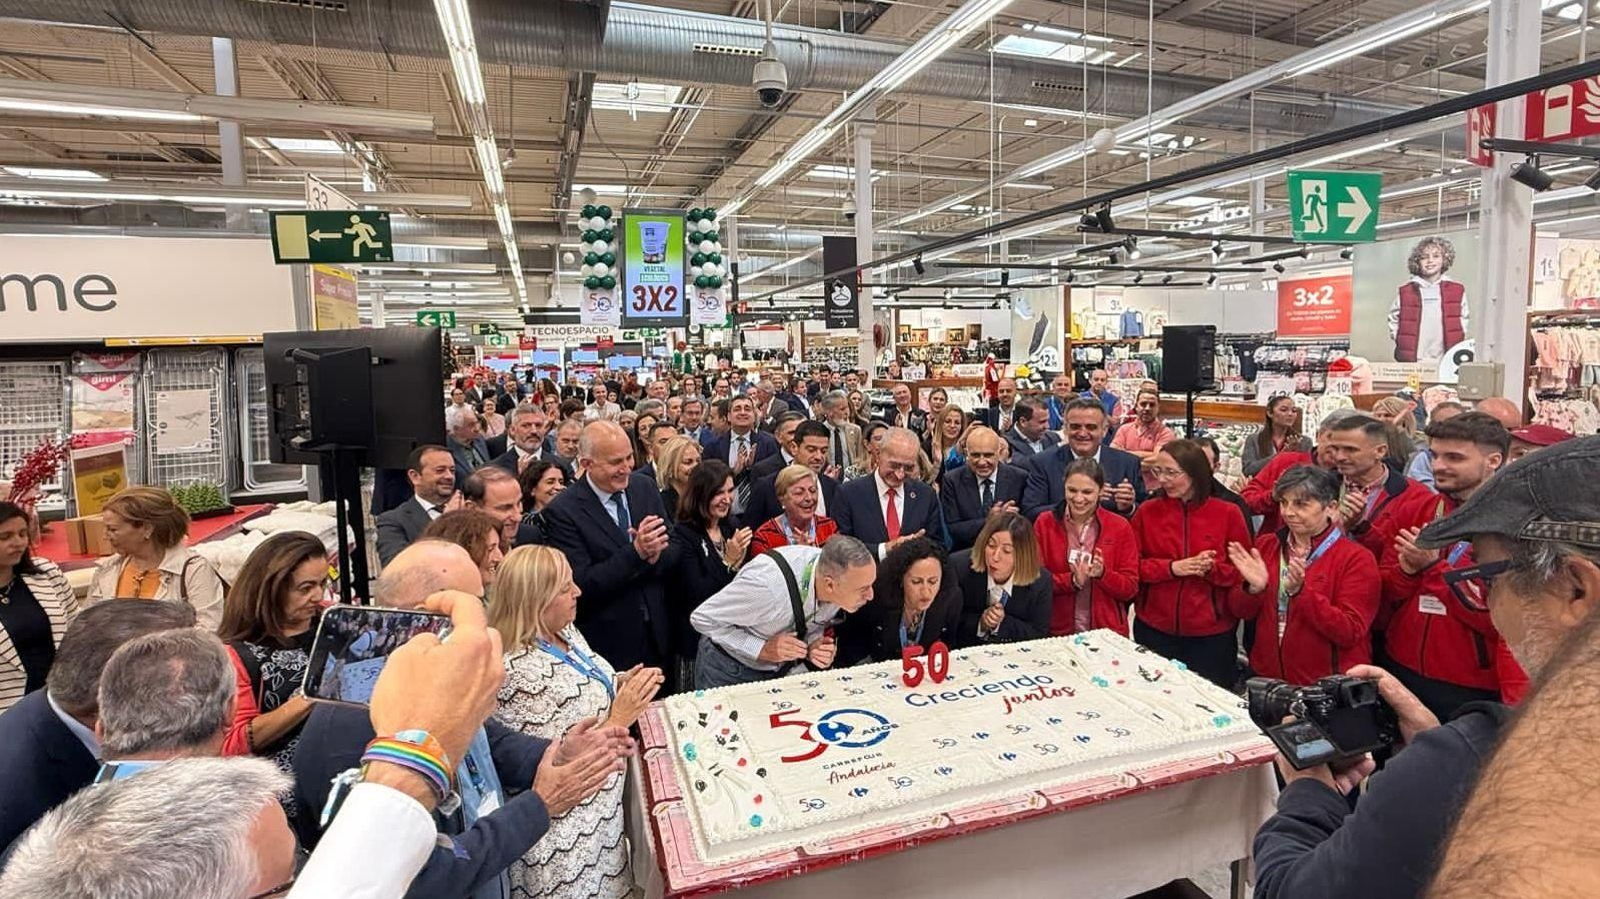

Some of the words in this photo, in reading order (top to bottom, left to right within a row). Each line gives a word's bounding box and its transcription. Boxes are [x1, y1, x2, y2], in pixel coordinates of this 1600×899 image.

[632, 284, 678, 312] 3X2
[1292, 284, 1335, 307] 3x2
[531, 326, 609, 336] TECNOESPACIO
[91, 374, 117, 385] gimi
[902, 641, 949, 688] 50
[904, 674, 1054, 707] Creciendo
[1002, 685, 1076, 714] juntos
